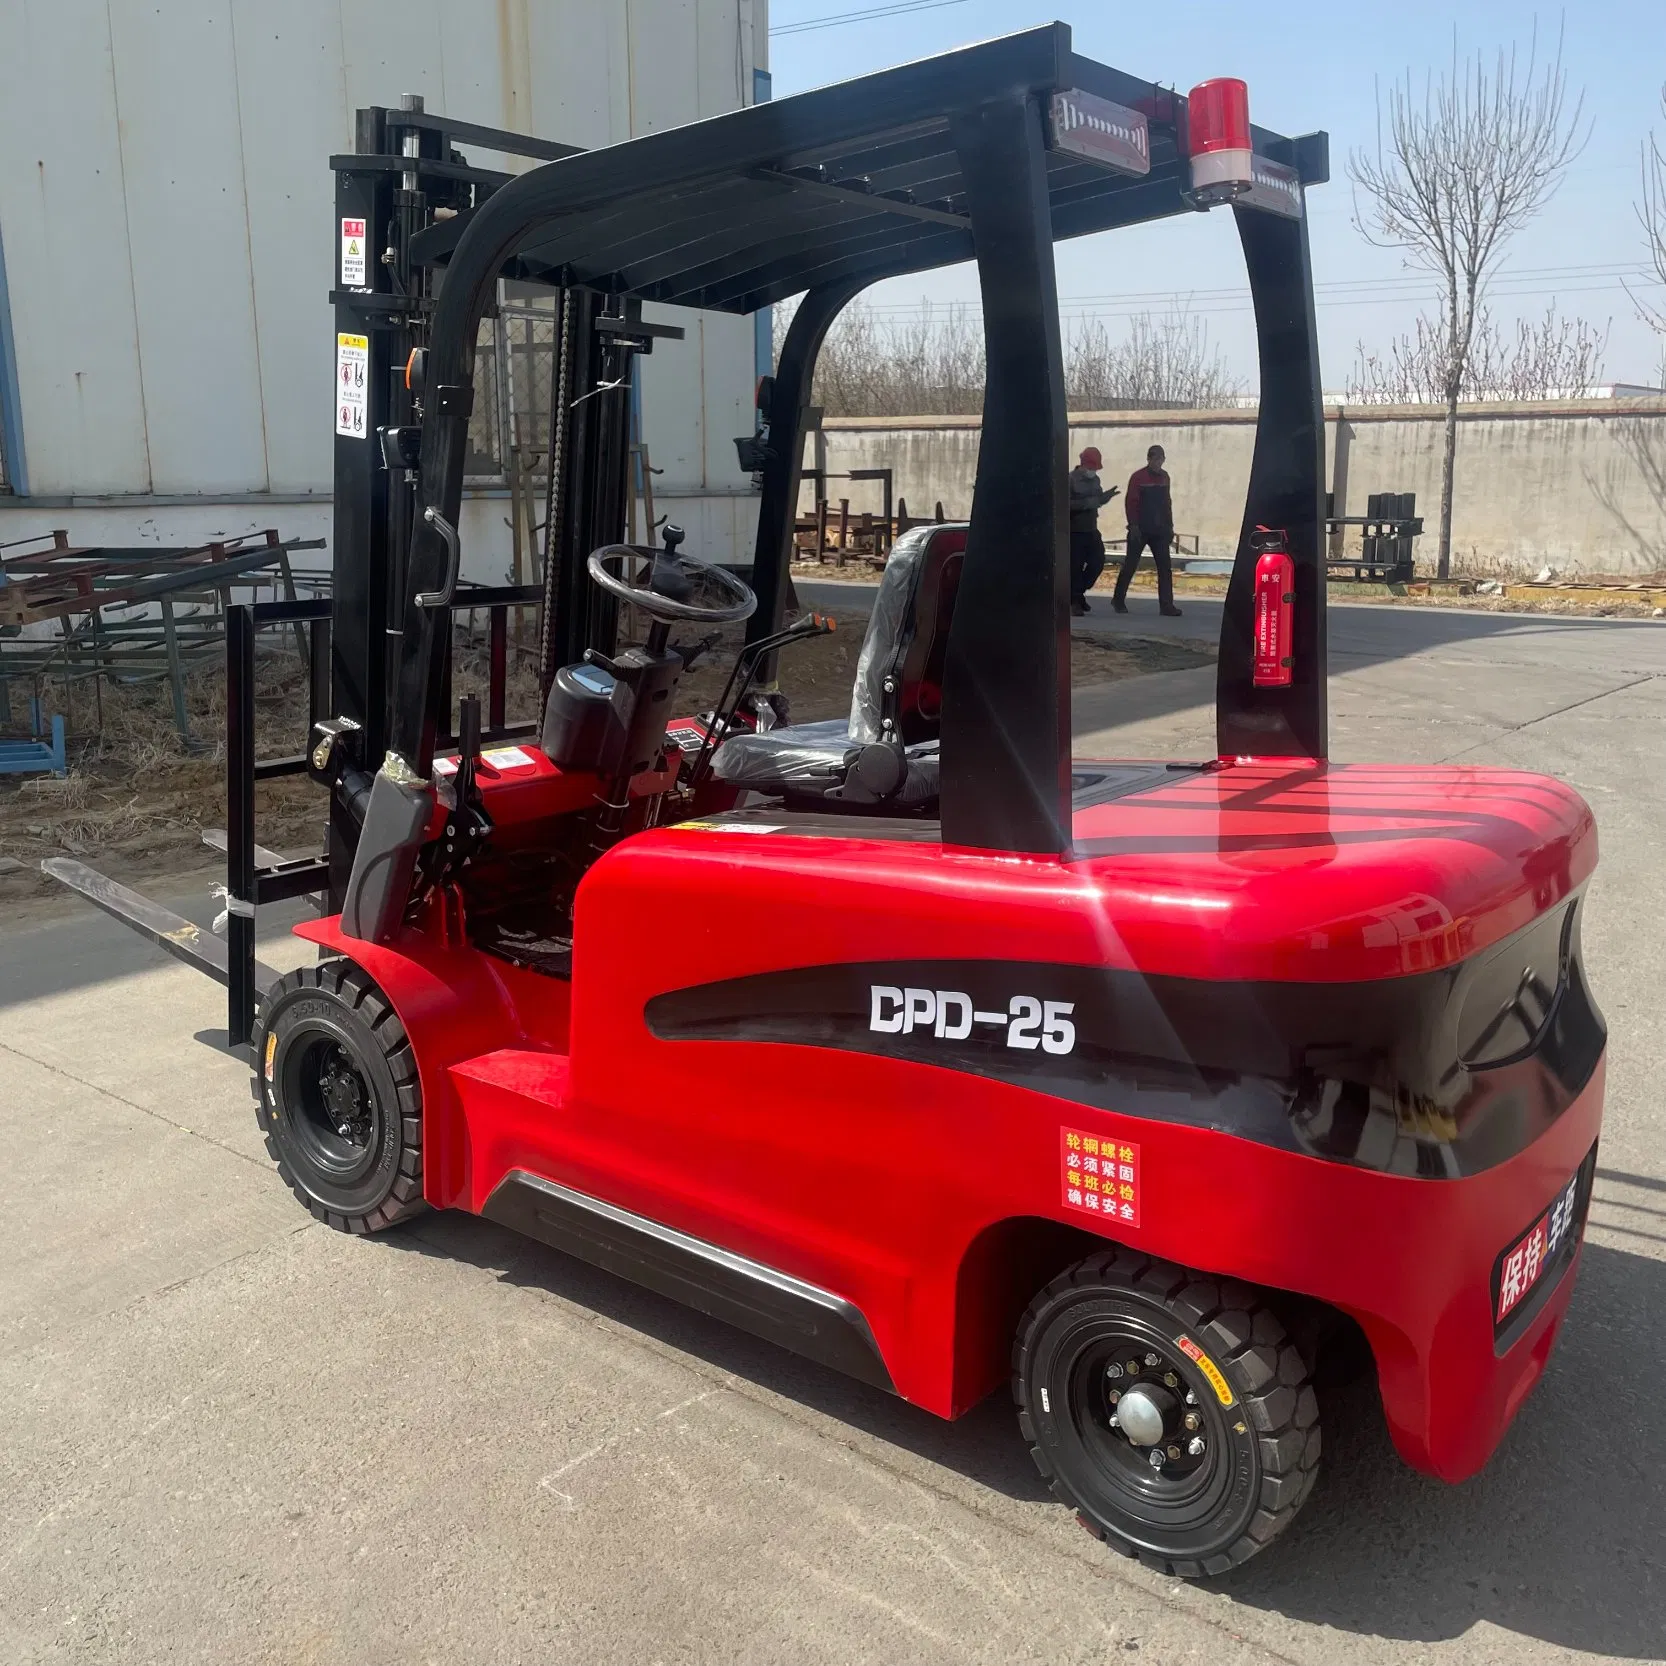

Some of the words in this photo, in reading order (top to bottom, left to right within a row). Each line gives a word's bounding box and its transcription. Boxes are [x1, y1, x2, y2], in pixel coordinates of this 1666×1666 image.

[1260, 592, 1268, 640] EXTINGUISHER
[869, 985, 1076, 1055] CPD-25
[1066, 1152, 1134, 1183] 必须紧固
[1066, 1170, 1135, 1201] 每班必检
[1067, 1188, 1135, 1221] 确保安全
